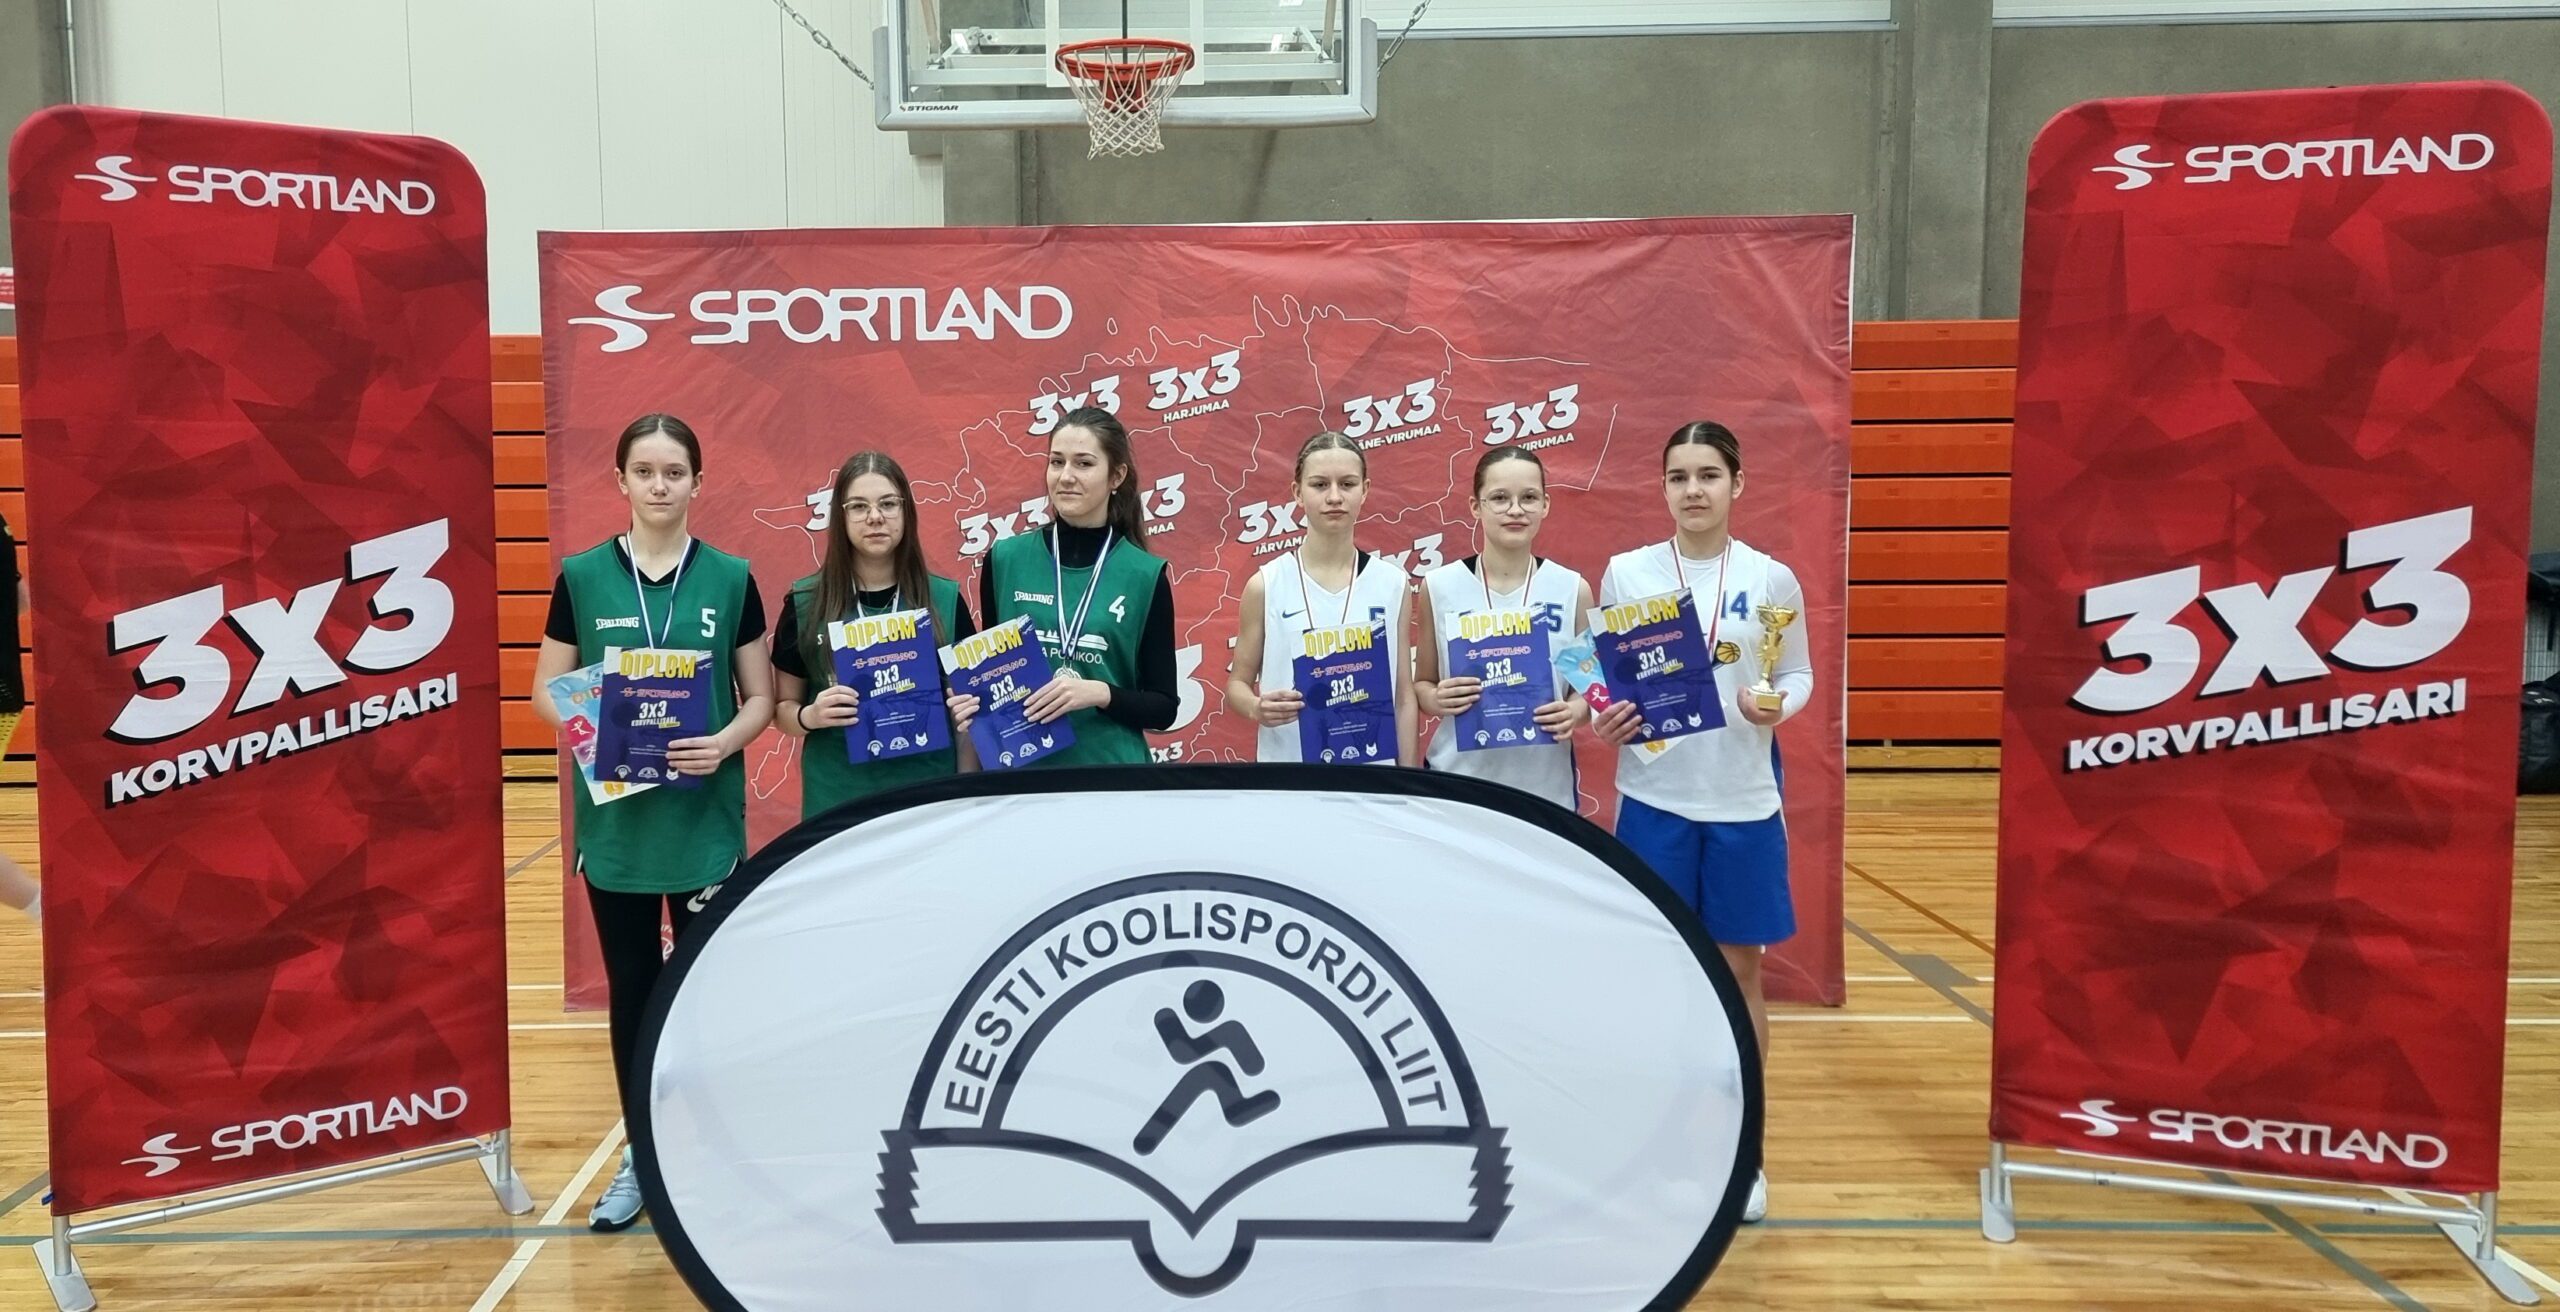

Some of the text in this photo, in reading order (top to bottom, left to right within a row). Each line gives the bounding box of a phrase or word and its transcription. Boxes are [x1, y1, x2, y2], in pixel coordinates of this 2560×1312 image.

[2184, 133, 2495, 184] SPORTLAND
[167, 165, 436, 216] SPORTLAND
[689, 285, 1073, 345] SPORTLAND
[1147, 349, 1241, 410] 3x3
[1163, 399, 1230, 423] HARJUMAA
[1343, 378, 1436, 438] 3x3
[1483, 384, 1579, 445] 3x3
[1358, 423, 1441, 450] ÄNE-VIRUMAA
[1518, 432, 1574, 451] VIRUMAA
[1145, 521, 1175, 536] MAA
[1237, 501, 1307, 543] 3x
[1252, 535, 1307, 556] JÄRVAM
[1013, 590, 1054, 606] SPALDING
[1108, 595, 1126, 624] 4
[1603, 596, 1681, 634] DIPLOM
[2070, 505, 2473, 713] 3x3
[109, 517, 455, 740] 3x3
[596, 616, 640, 631] SPALDING
[701, 608, 716, 638] 5
[844, 615, 917, 649] DIPLOM
[1304, 626, 1372, 657] DIPLOM
[1460, 611, 1532, 640] DIPLOM
[620, 651, 697, 679] DIPLOM
[952, 624, 1023, 669] DIPLOM
[110, 672, 458, 804] KORVPALLISARI
[2068, 678, 2467, 771] KORVPALLISARI
[944, 902, 1447, 1116] EESTI KOOLISPORDI LIIT
[210, 1086, 468, 1164] SPORTLAND
[2148, 1109, 2448, 1169] SPORTLAND
